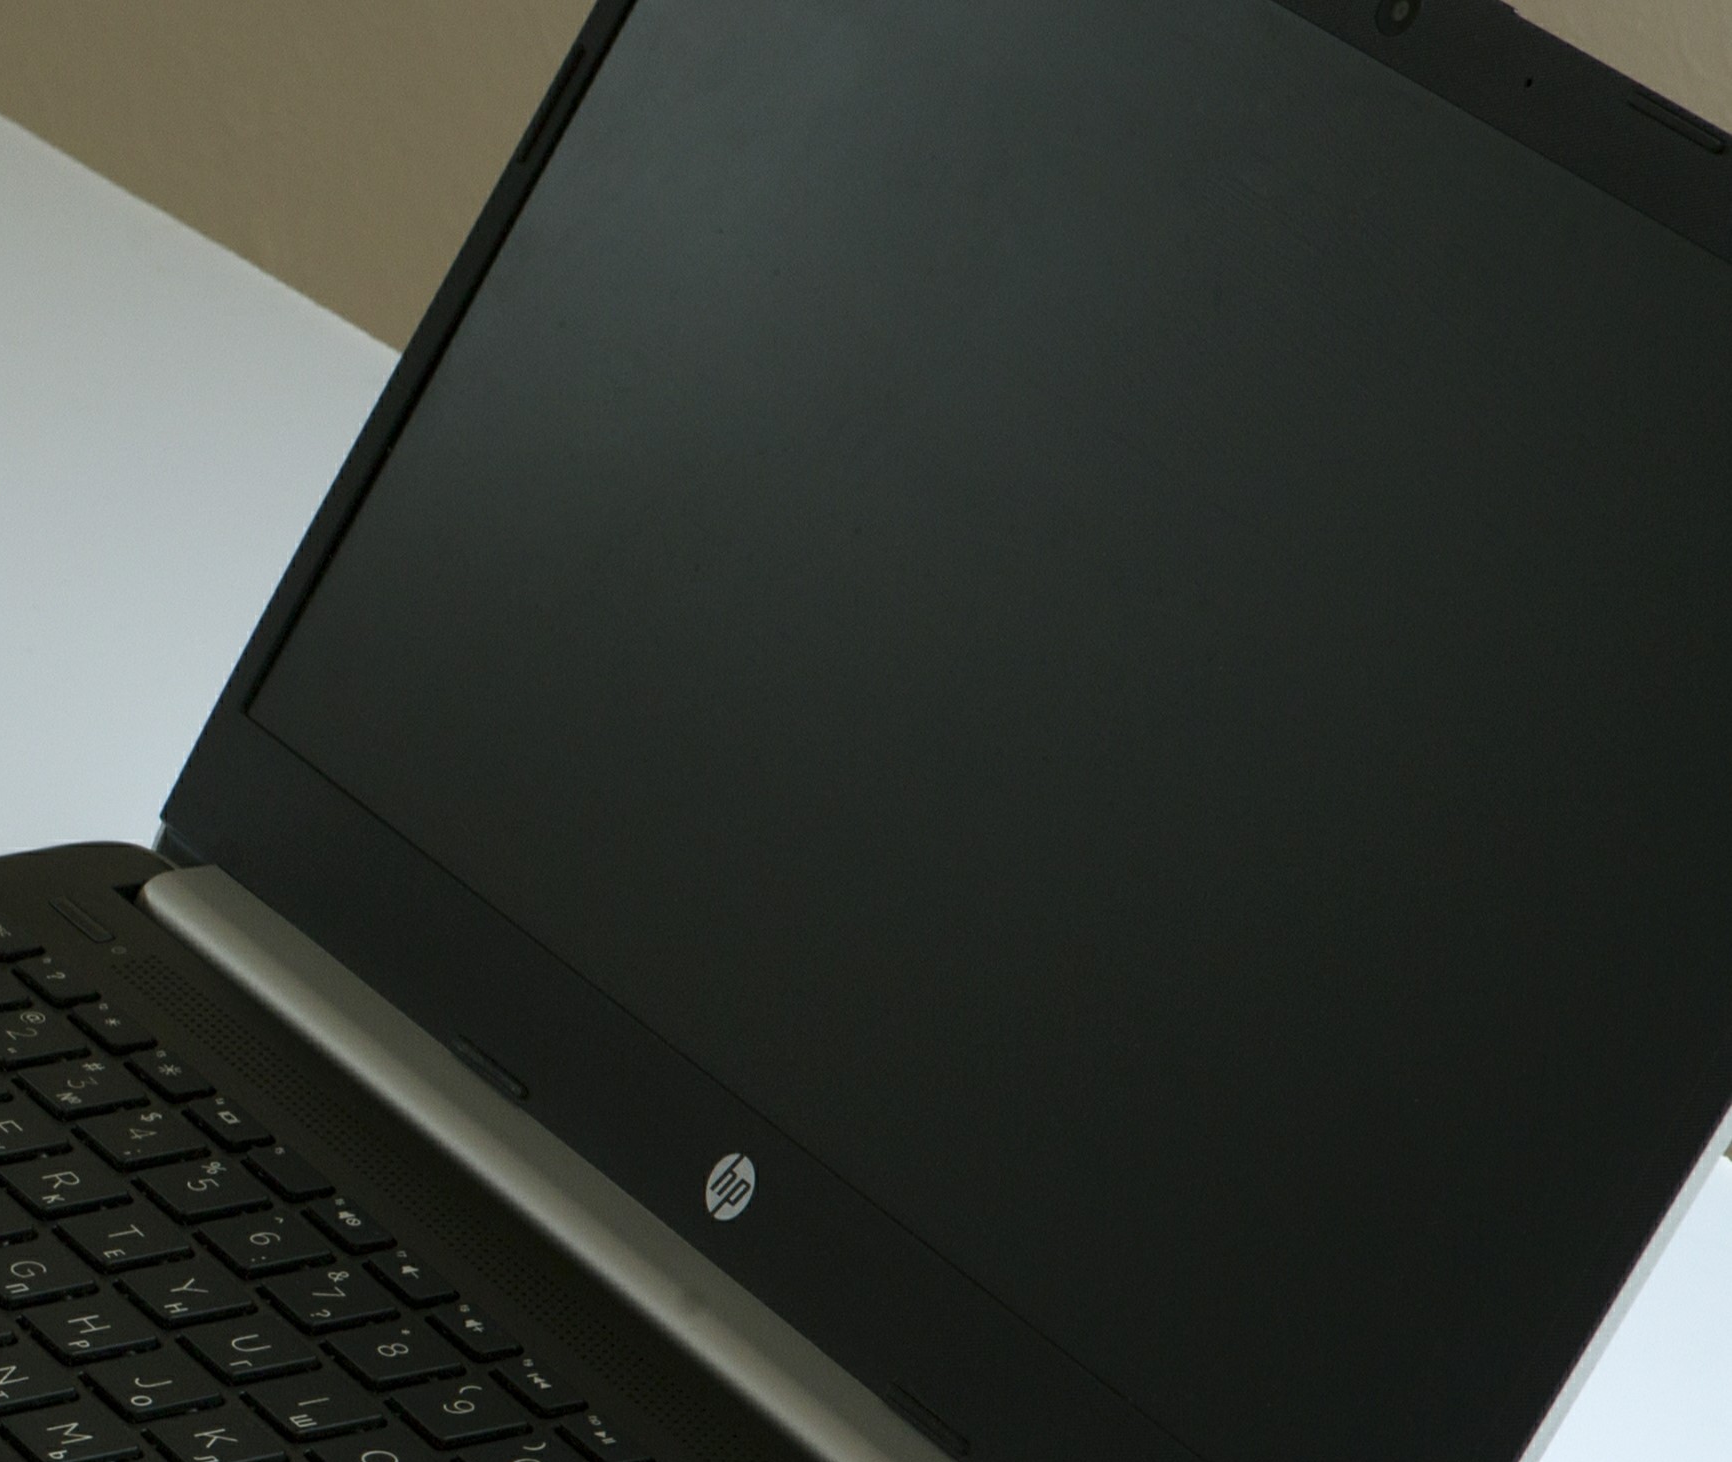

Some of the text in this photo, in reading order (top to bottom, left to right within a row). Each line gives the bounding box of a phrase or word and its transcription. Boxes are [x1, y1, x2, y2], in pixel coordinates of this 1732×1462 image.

[41, 1171, 81, 1189] R
[186, 1178, 219, 1192] 5
[108, 1224, 145, 1238] T
[249, 1231, 281, 1246] 6
[10, 1260, 47, 1279] G
[5, 1282, 30, 1294] П
[170, 1277, 208, 1293] Y
[312, 1286, 346, 1298] 7
[67, 1314, 111, 1334] H
[230, 1333, 272, 1353] U
[376, 1342, 409, 1358] 8
[134, 1377, 173, 1388] J
[442, 1399, 475, 1415] 9
[290, 1413, 317, 1429] Ш
[46, 1421, 93, 1445] M
[193, 1428, 238, 1449] K
